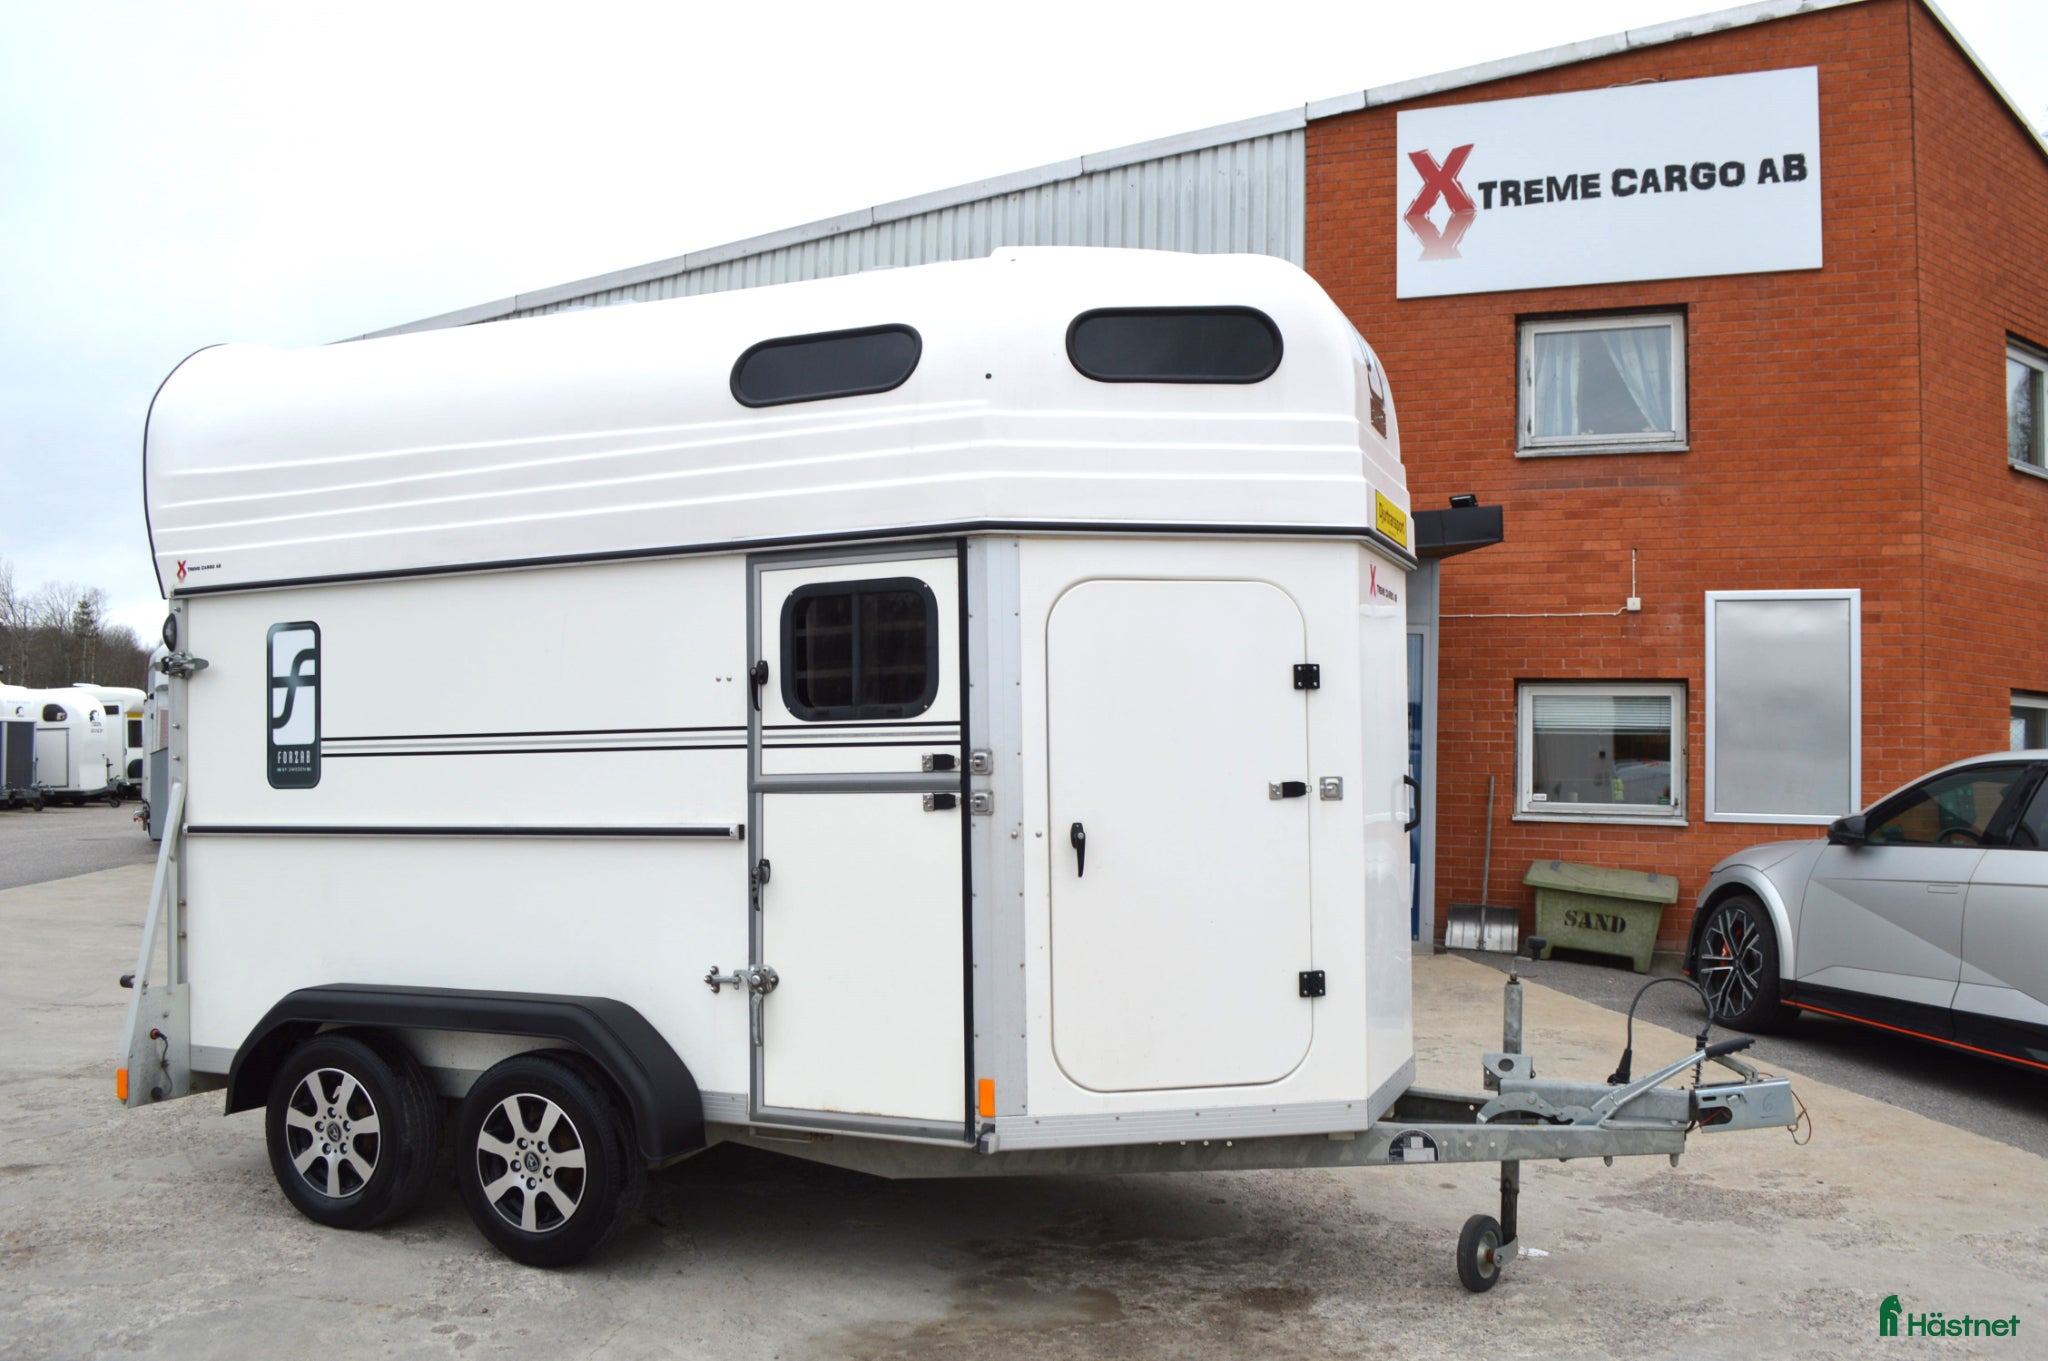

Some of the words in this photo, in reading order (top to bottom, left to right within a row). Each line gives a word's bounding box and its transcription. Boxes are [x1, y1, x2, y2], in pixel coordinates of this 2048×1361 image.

[1610, 161, 1745, 197] CARGO
[1757, 152, 1808, 184] AB
[1564, 909, 1627, 934] SAND
